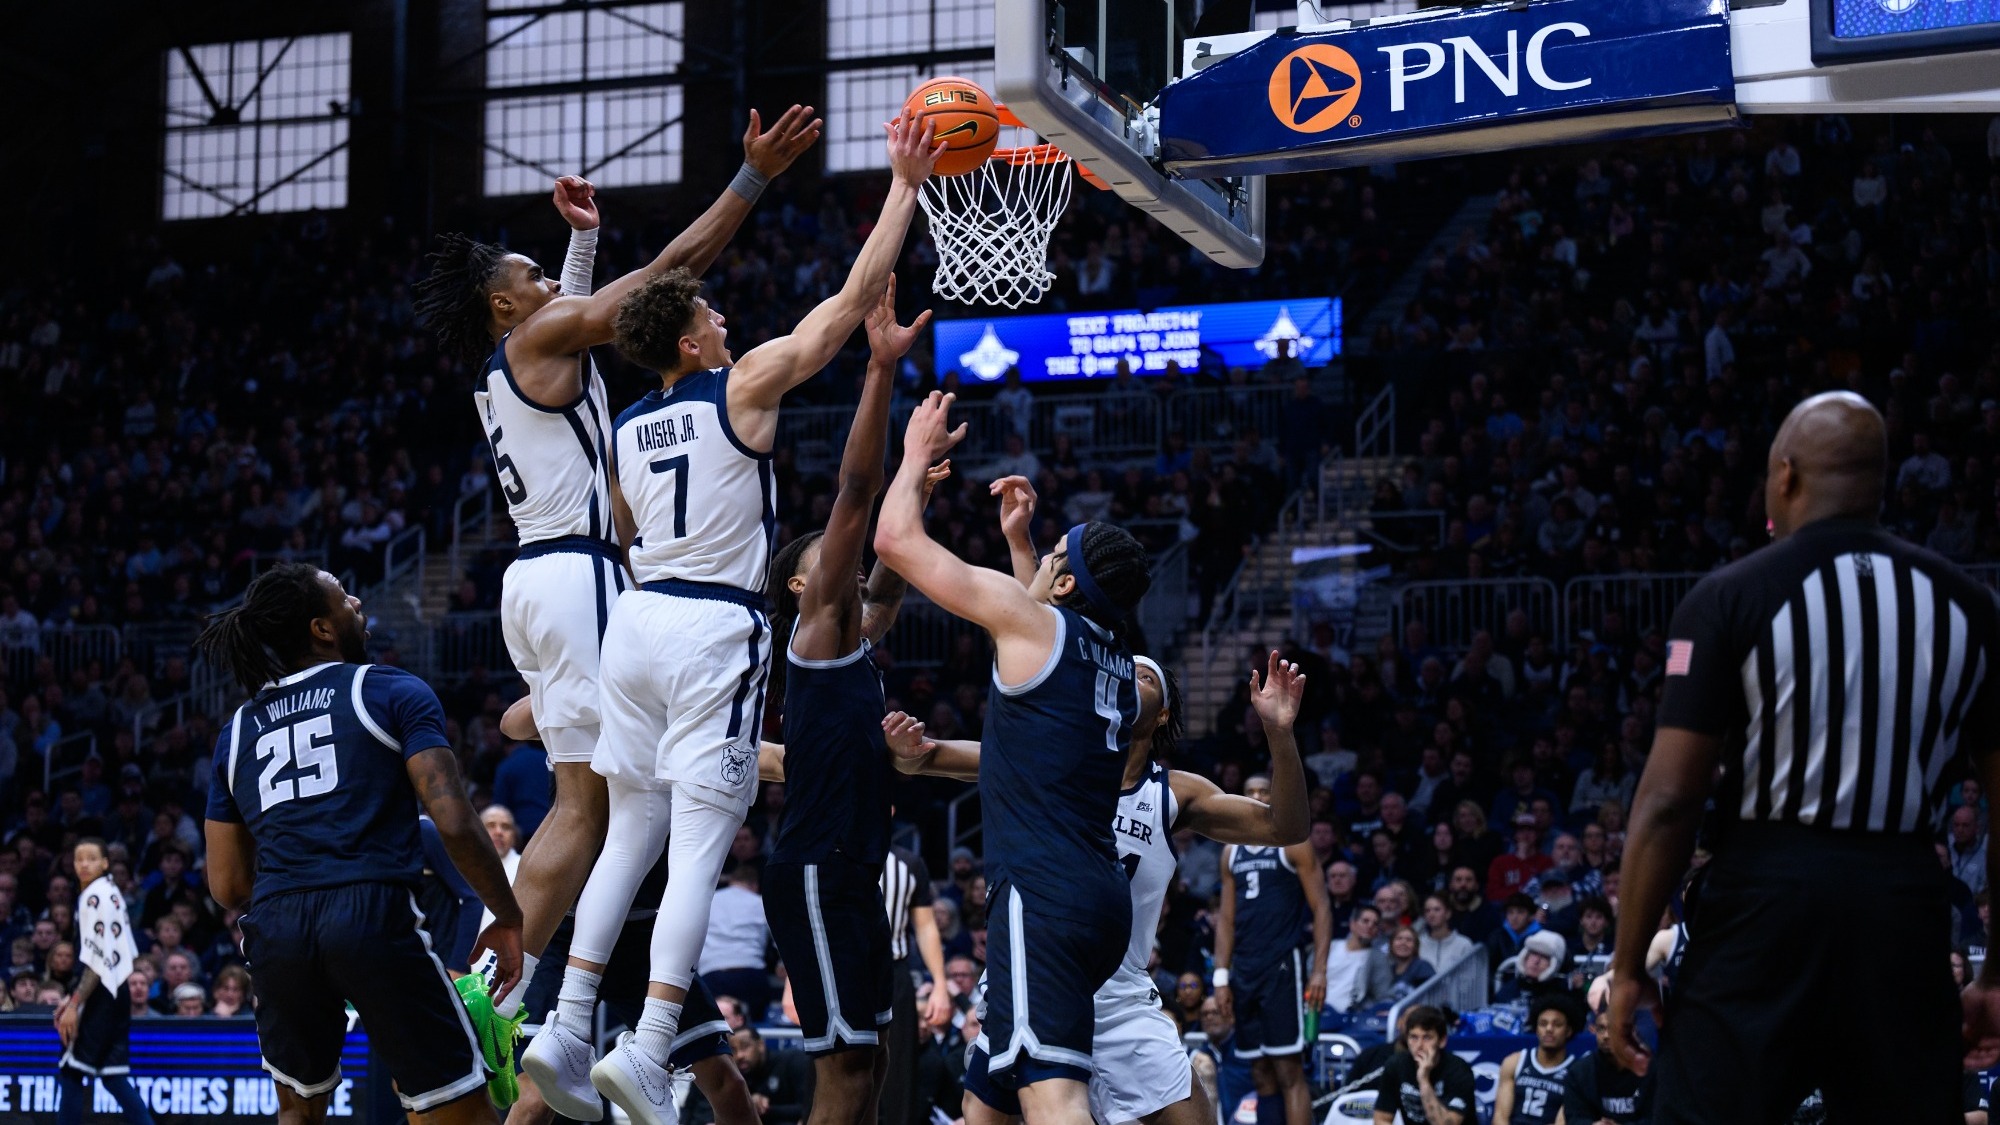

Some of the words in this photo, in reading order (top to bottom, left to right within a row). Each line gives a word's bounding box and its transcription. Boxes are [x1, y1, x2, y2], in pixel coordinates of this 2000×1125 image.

[1377, 22, 1592, 112] PNC
[925, 90, 978, 107] ELITE
[636, 416, 677, 452] KAISER
[681, 413, 699, 443] JR.
[650, 453, 689, 538] 7
[1078, 637, 1090, 660] C.
[253, 715, 266, 732] J.
[266, 687, 335, 722] WILLIAMS
[1095, 669, 1122, 752] 4
[255, 713, 338, 812] 25
[1115, 814, 1152, 845] LER
[1245, 870, 1260, 900] 3
[233, 1078, 353, 1116] MUE
[1521, 1086, 1548, 1117] 12
